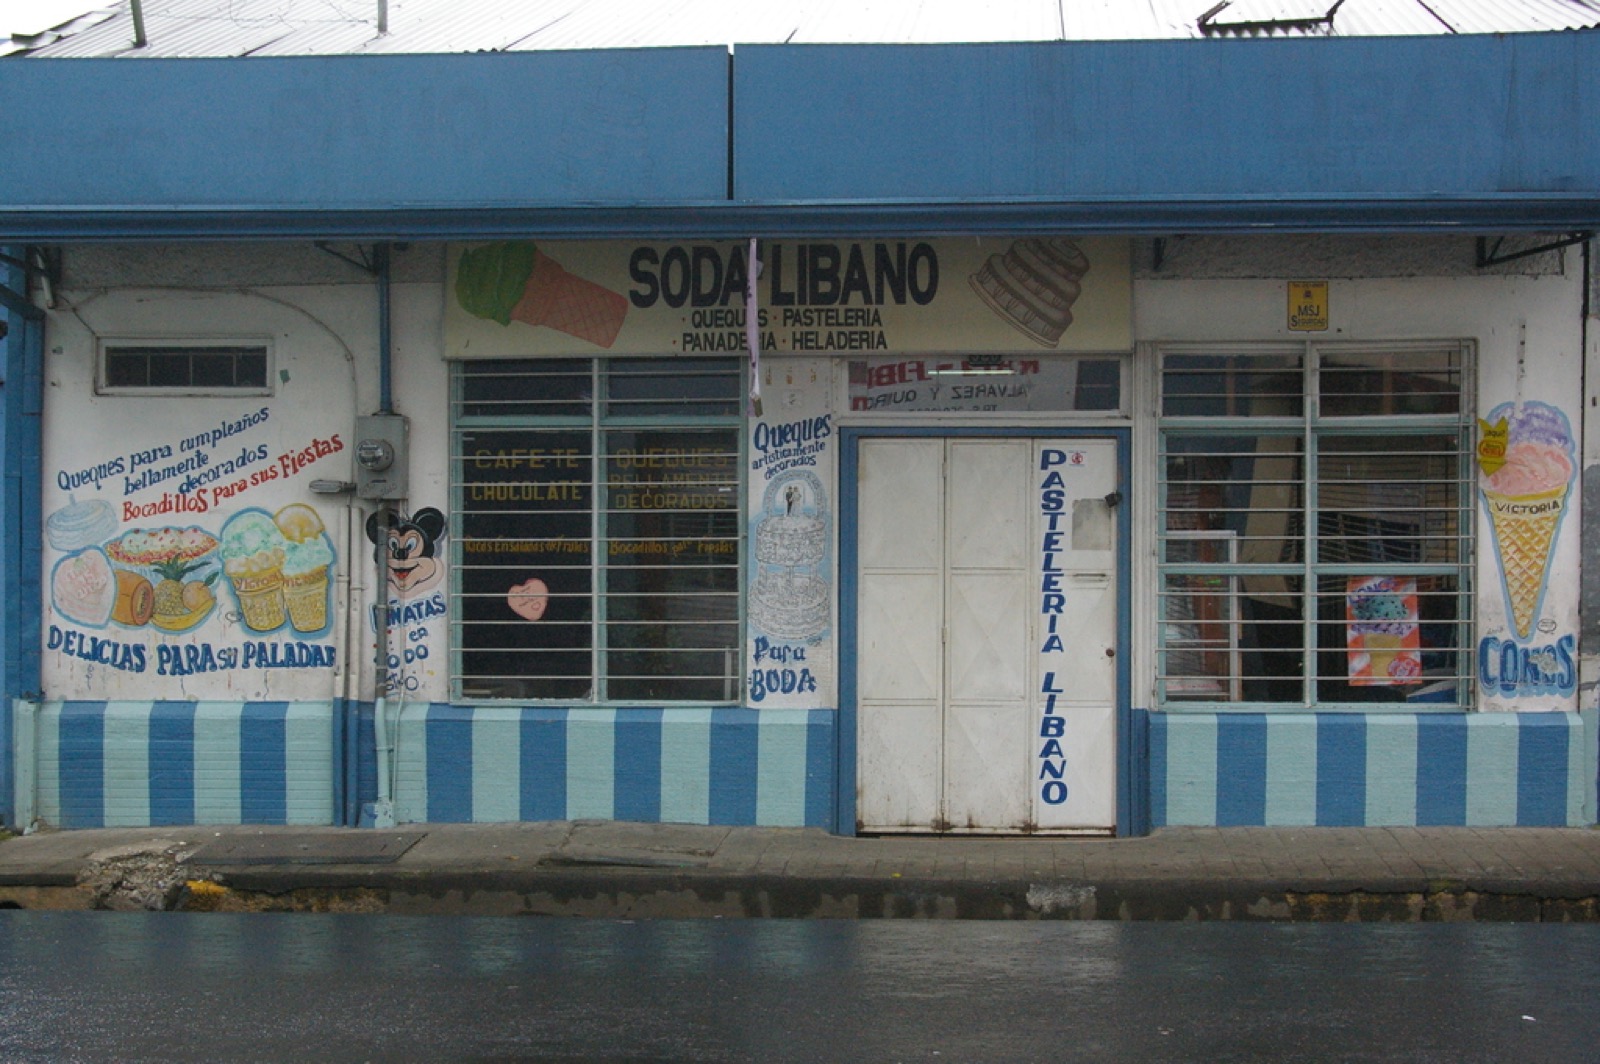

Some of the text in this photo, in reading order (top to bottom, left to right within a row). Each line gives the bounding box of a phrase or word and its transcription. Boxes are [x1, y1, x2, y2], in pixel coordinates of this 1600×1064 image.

[629, 242, 938, 308] SODA LIBANO
[692, 308, 883, 329] QUEQUS PASTELERIA
[682, 331, 888, 351] PANADEIA HELADERIA
[57, 407, 270, 492] Queques para cumpleaños
[754, 413, 832, 453] Queques
[123, 451, 210, 496] bellamente
[178, 444, 268, 494] decorados
[251, 467, 279, 488] sus
[277, 434, 344, 478] Fiestas
[615, 448, 728, 468] QUEQUES
[471, 481, 583, 500] CHOCOLATE
[615, 493, 728, 508] DECORADOS
[1495, 500, 1560, 514] VICTORIA
[1041, 450, 1067, 653] PASTELERIA
[47, 624, 146, 673] DELICIAS
[157, 642, 217, 675] PARA
[750, 668, 817, 702] BODA
[1039, 672, 1068, 805] LIBANO
